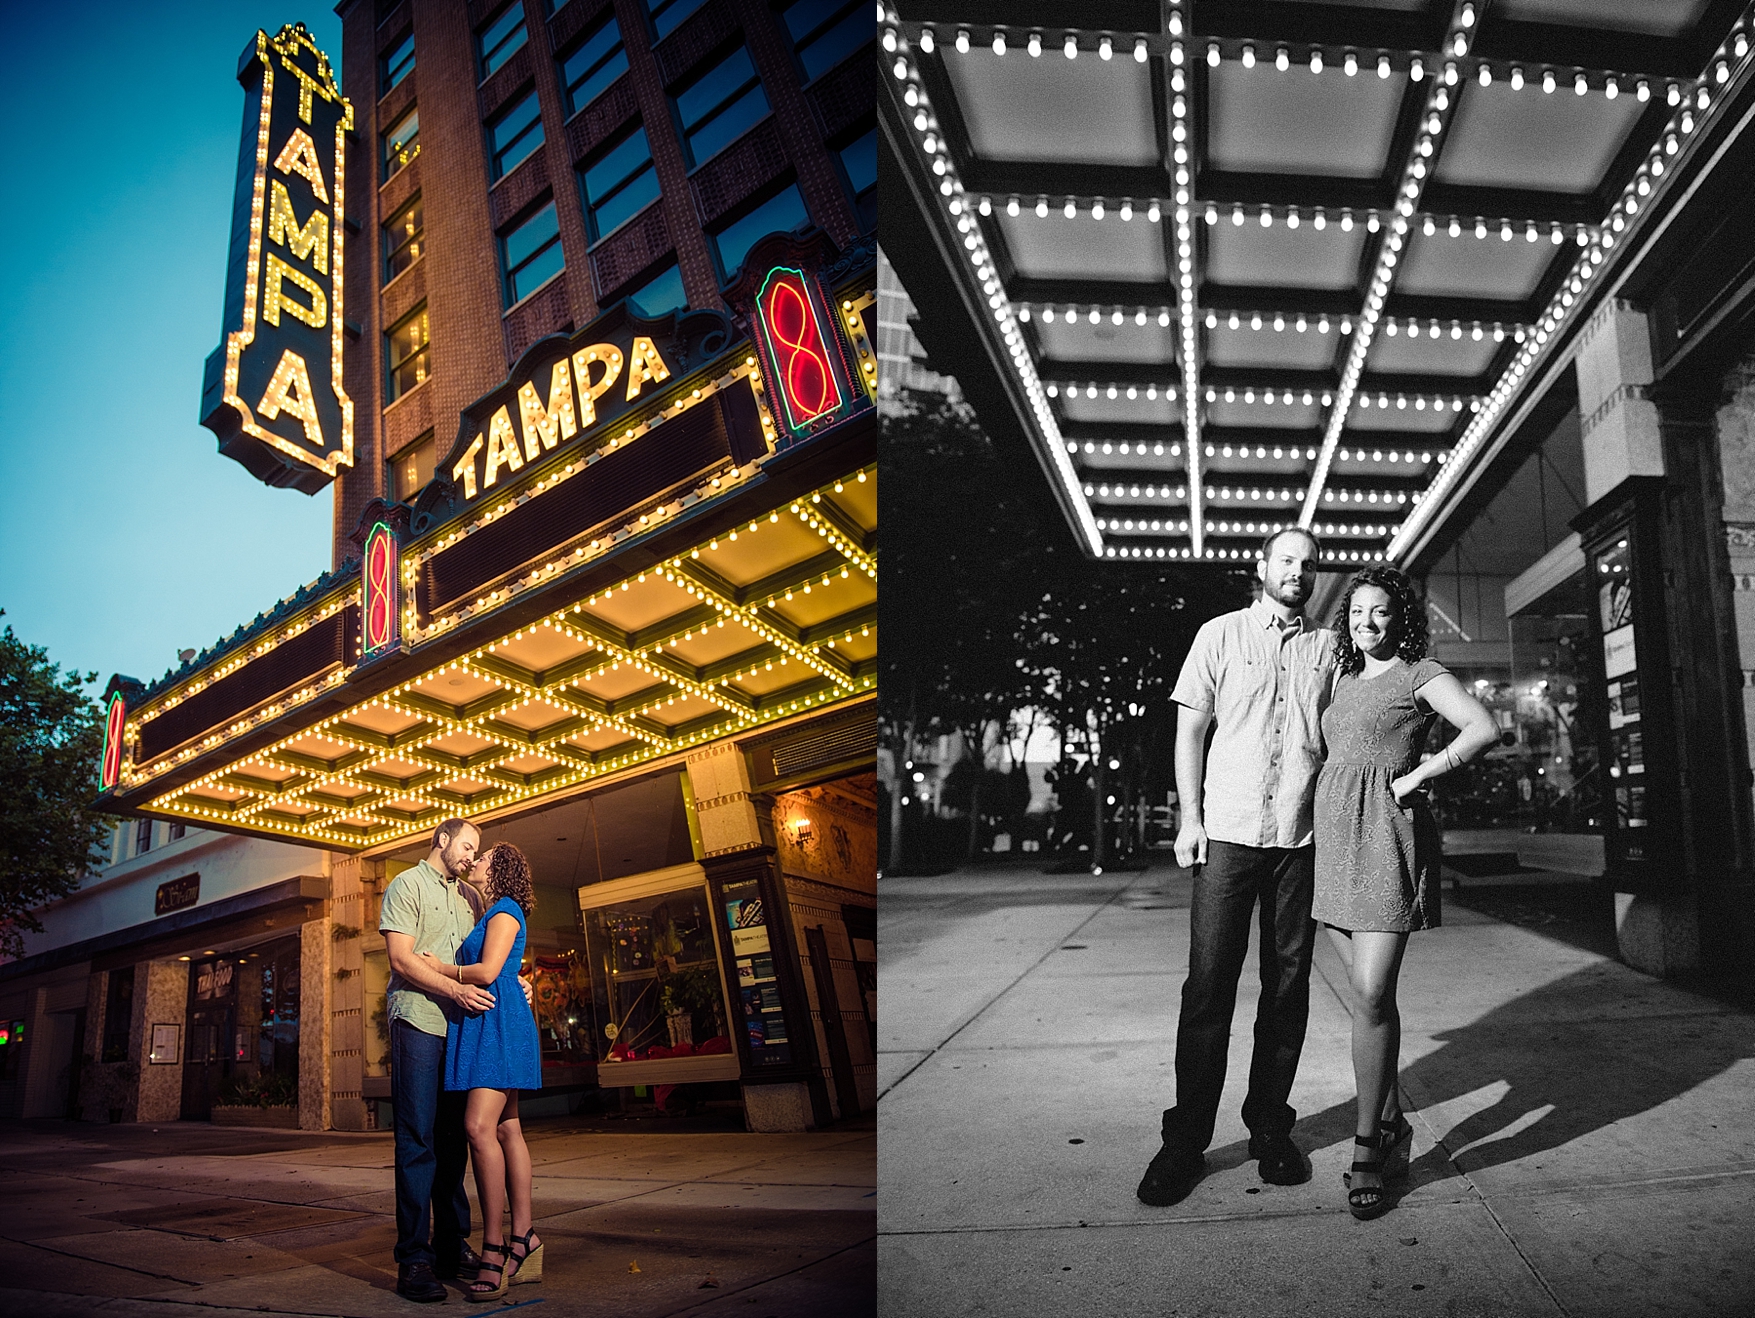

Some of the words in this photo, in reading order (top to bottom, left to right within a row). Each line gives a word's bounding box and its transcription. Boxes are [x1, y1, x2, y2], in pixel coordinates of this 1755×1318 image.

[257, 56, 332, 446] TAMPA
[452, 336, 671, 500] TAMPA
[197, 972, 214, 994] THAI
